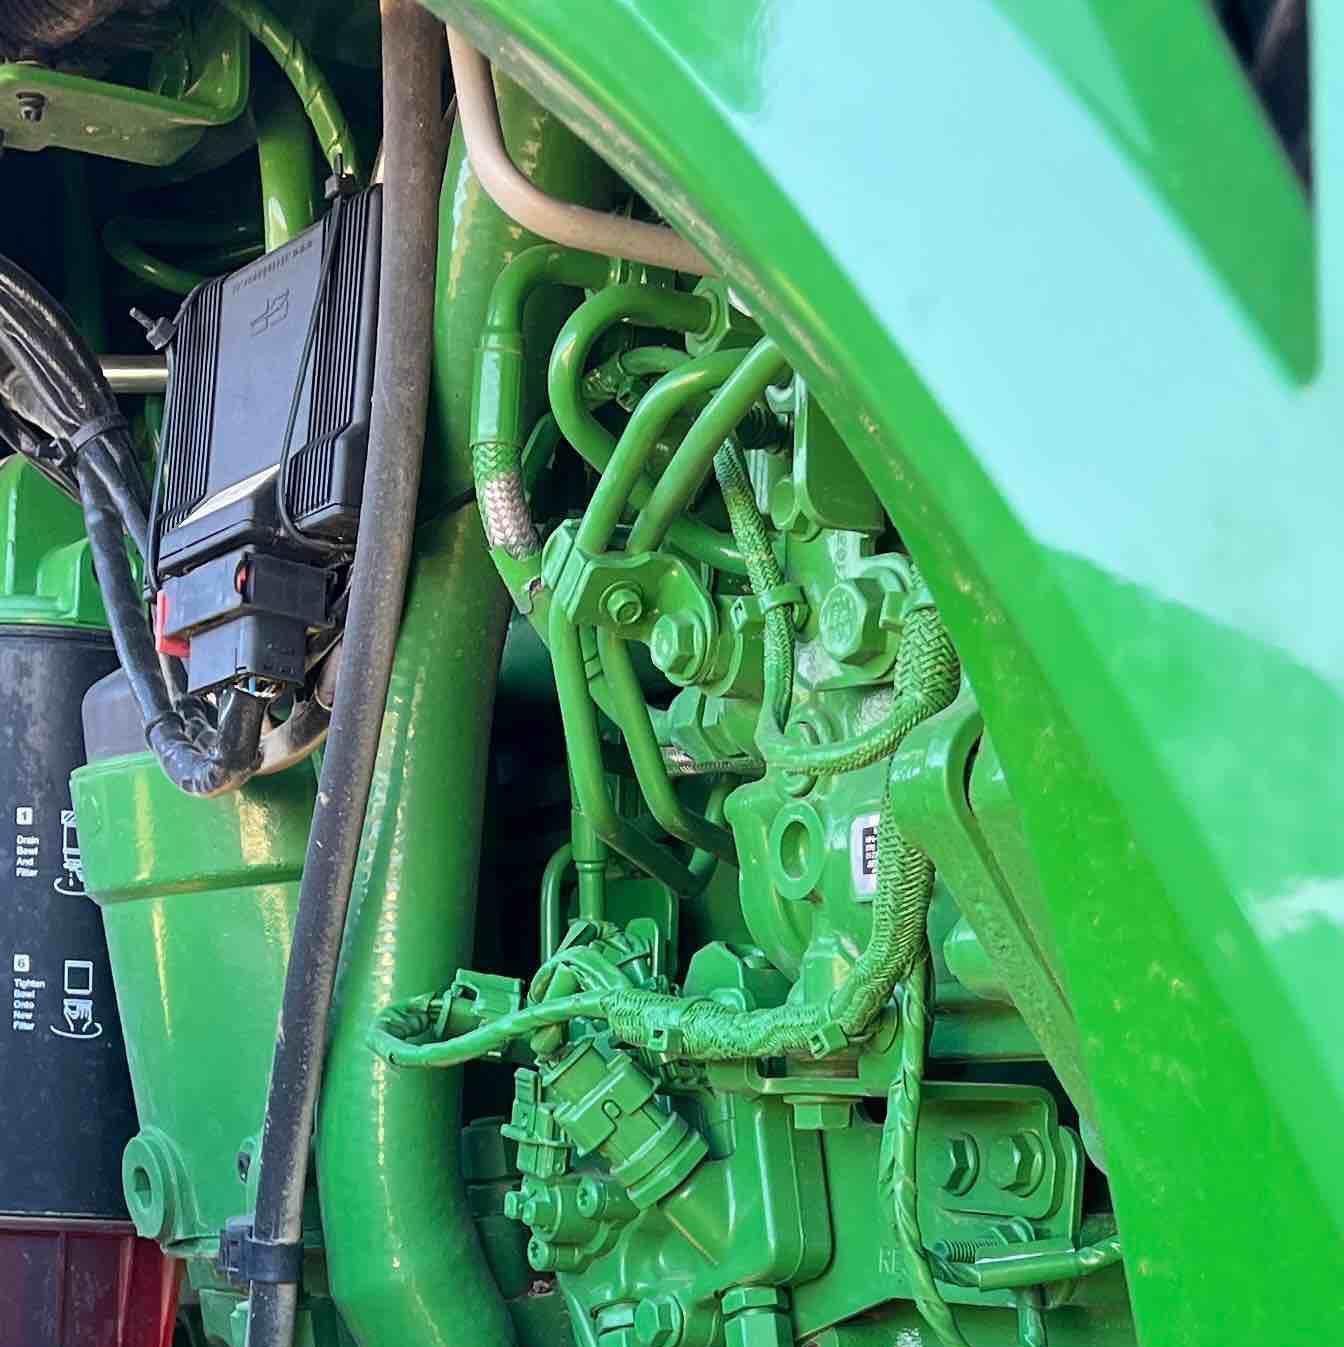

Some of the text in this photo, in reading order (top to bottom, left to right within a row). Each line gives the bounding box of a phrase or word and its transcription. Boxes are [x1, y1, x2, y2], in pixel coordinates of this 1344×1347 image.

[16, 834, 40, 845] Drain
[16, 846, 38, 856] Bowl
[16, 857, 34, 866] And
[16, 867, 38, 877] Filter
[14, 978, 46, 989] Tighten
